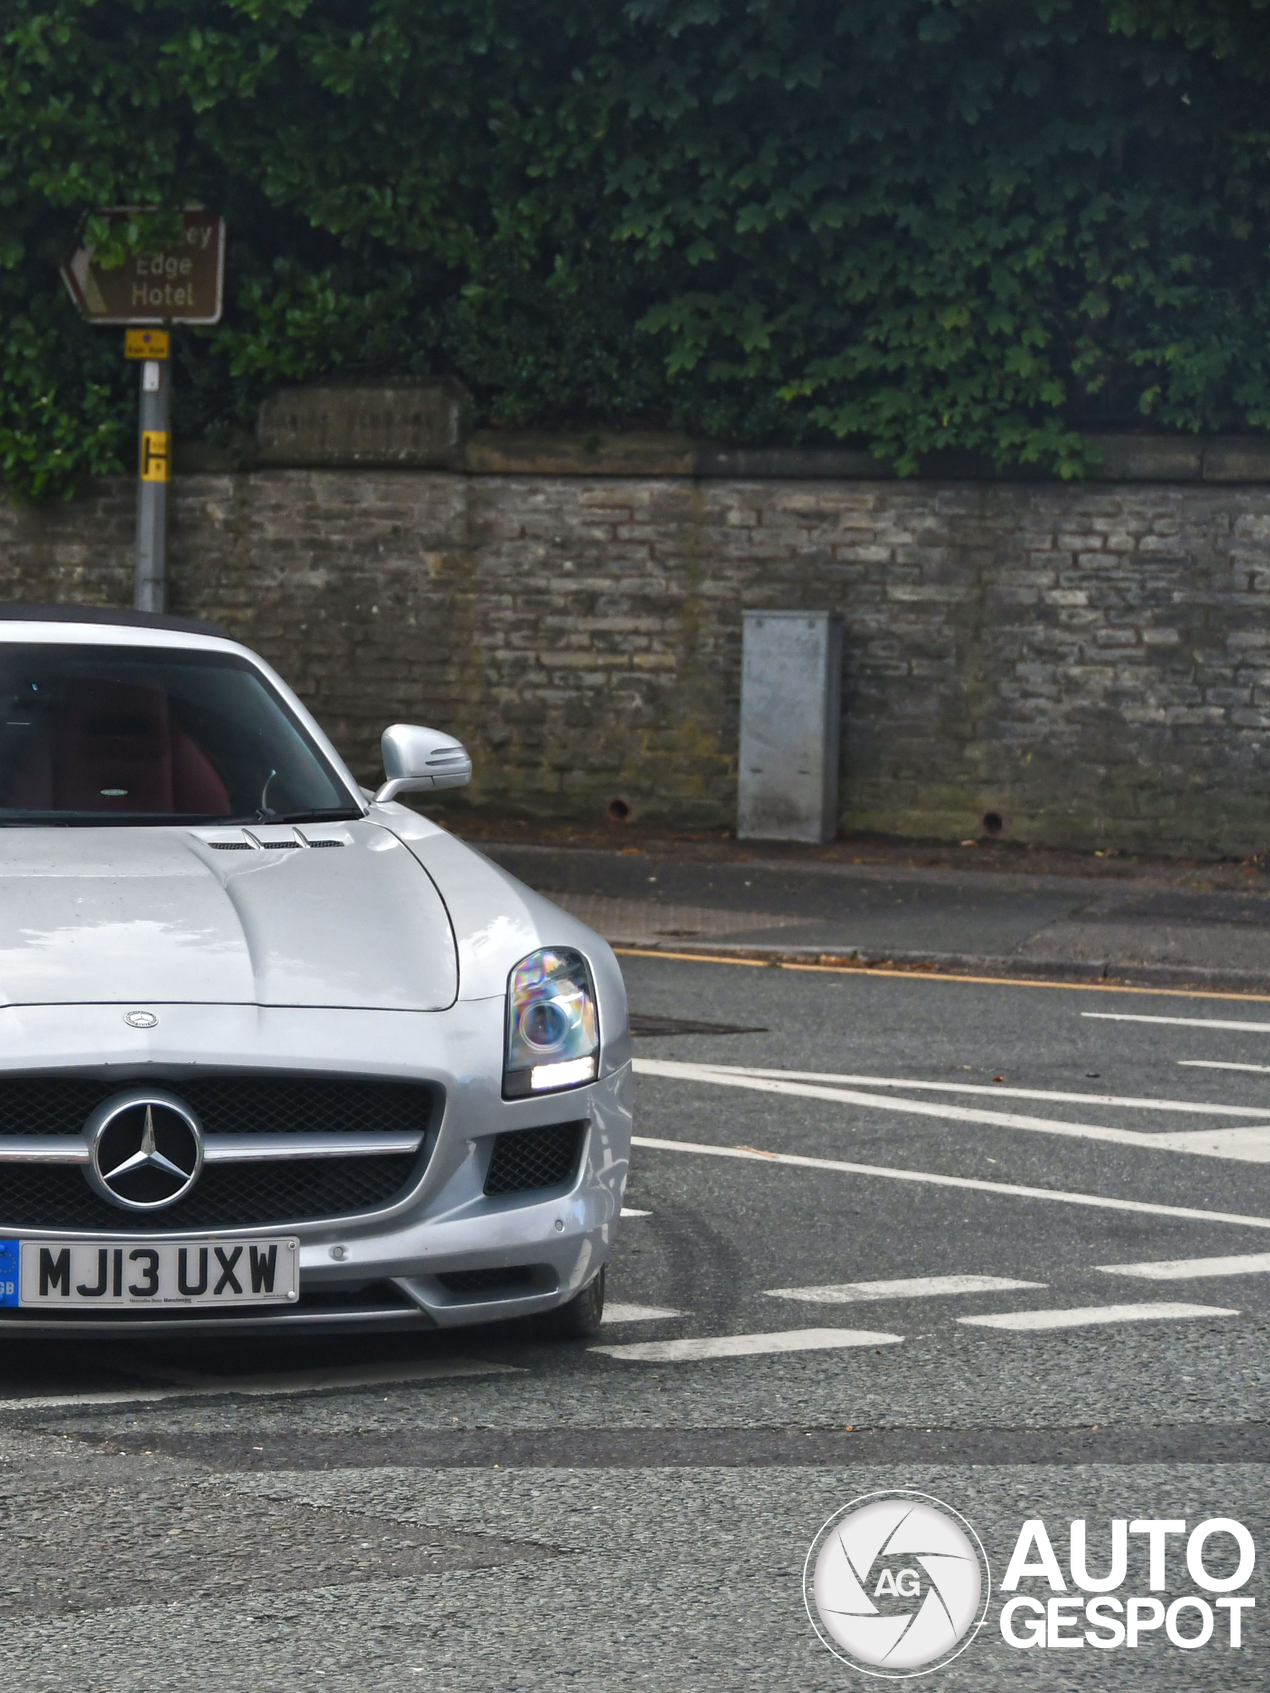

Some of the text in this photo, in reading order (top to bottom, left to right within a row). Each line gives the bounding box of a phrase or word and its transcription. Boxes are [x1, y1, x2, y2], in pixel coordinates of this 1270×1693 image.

[136, 254, 193, 279] Edge
[131, 282, 194, 306] Hotel
[177, 1244, 278, 1296] UXW
